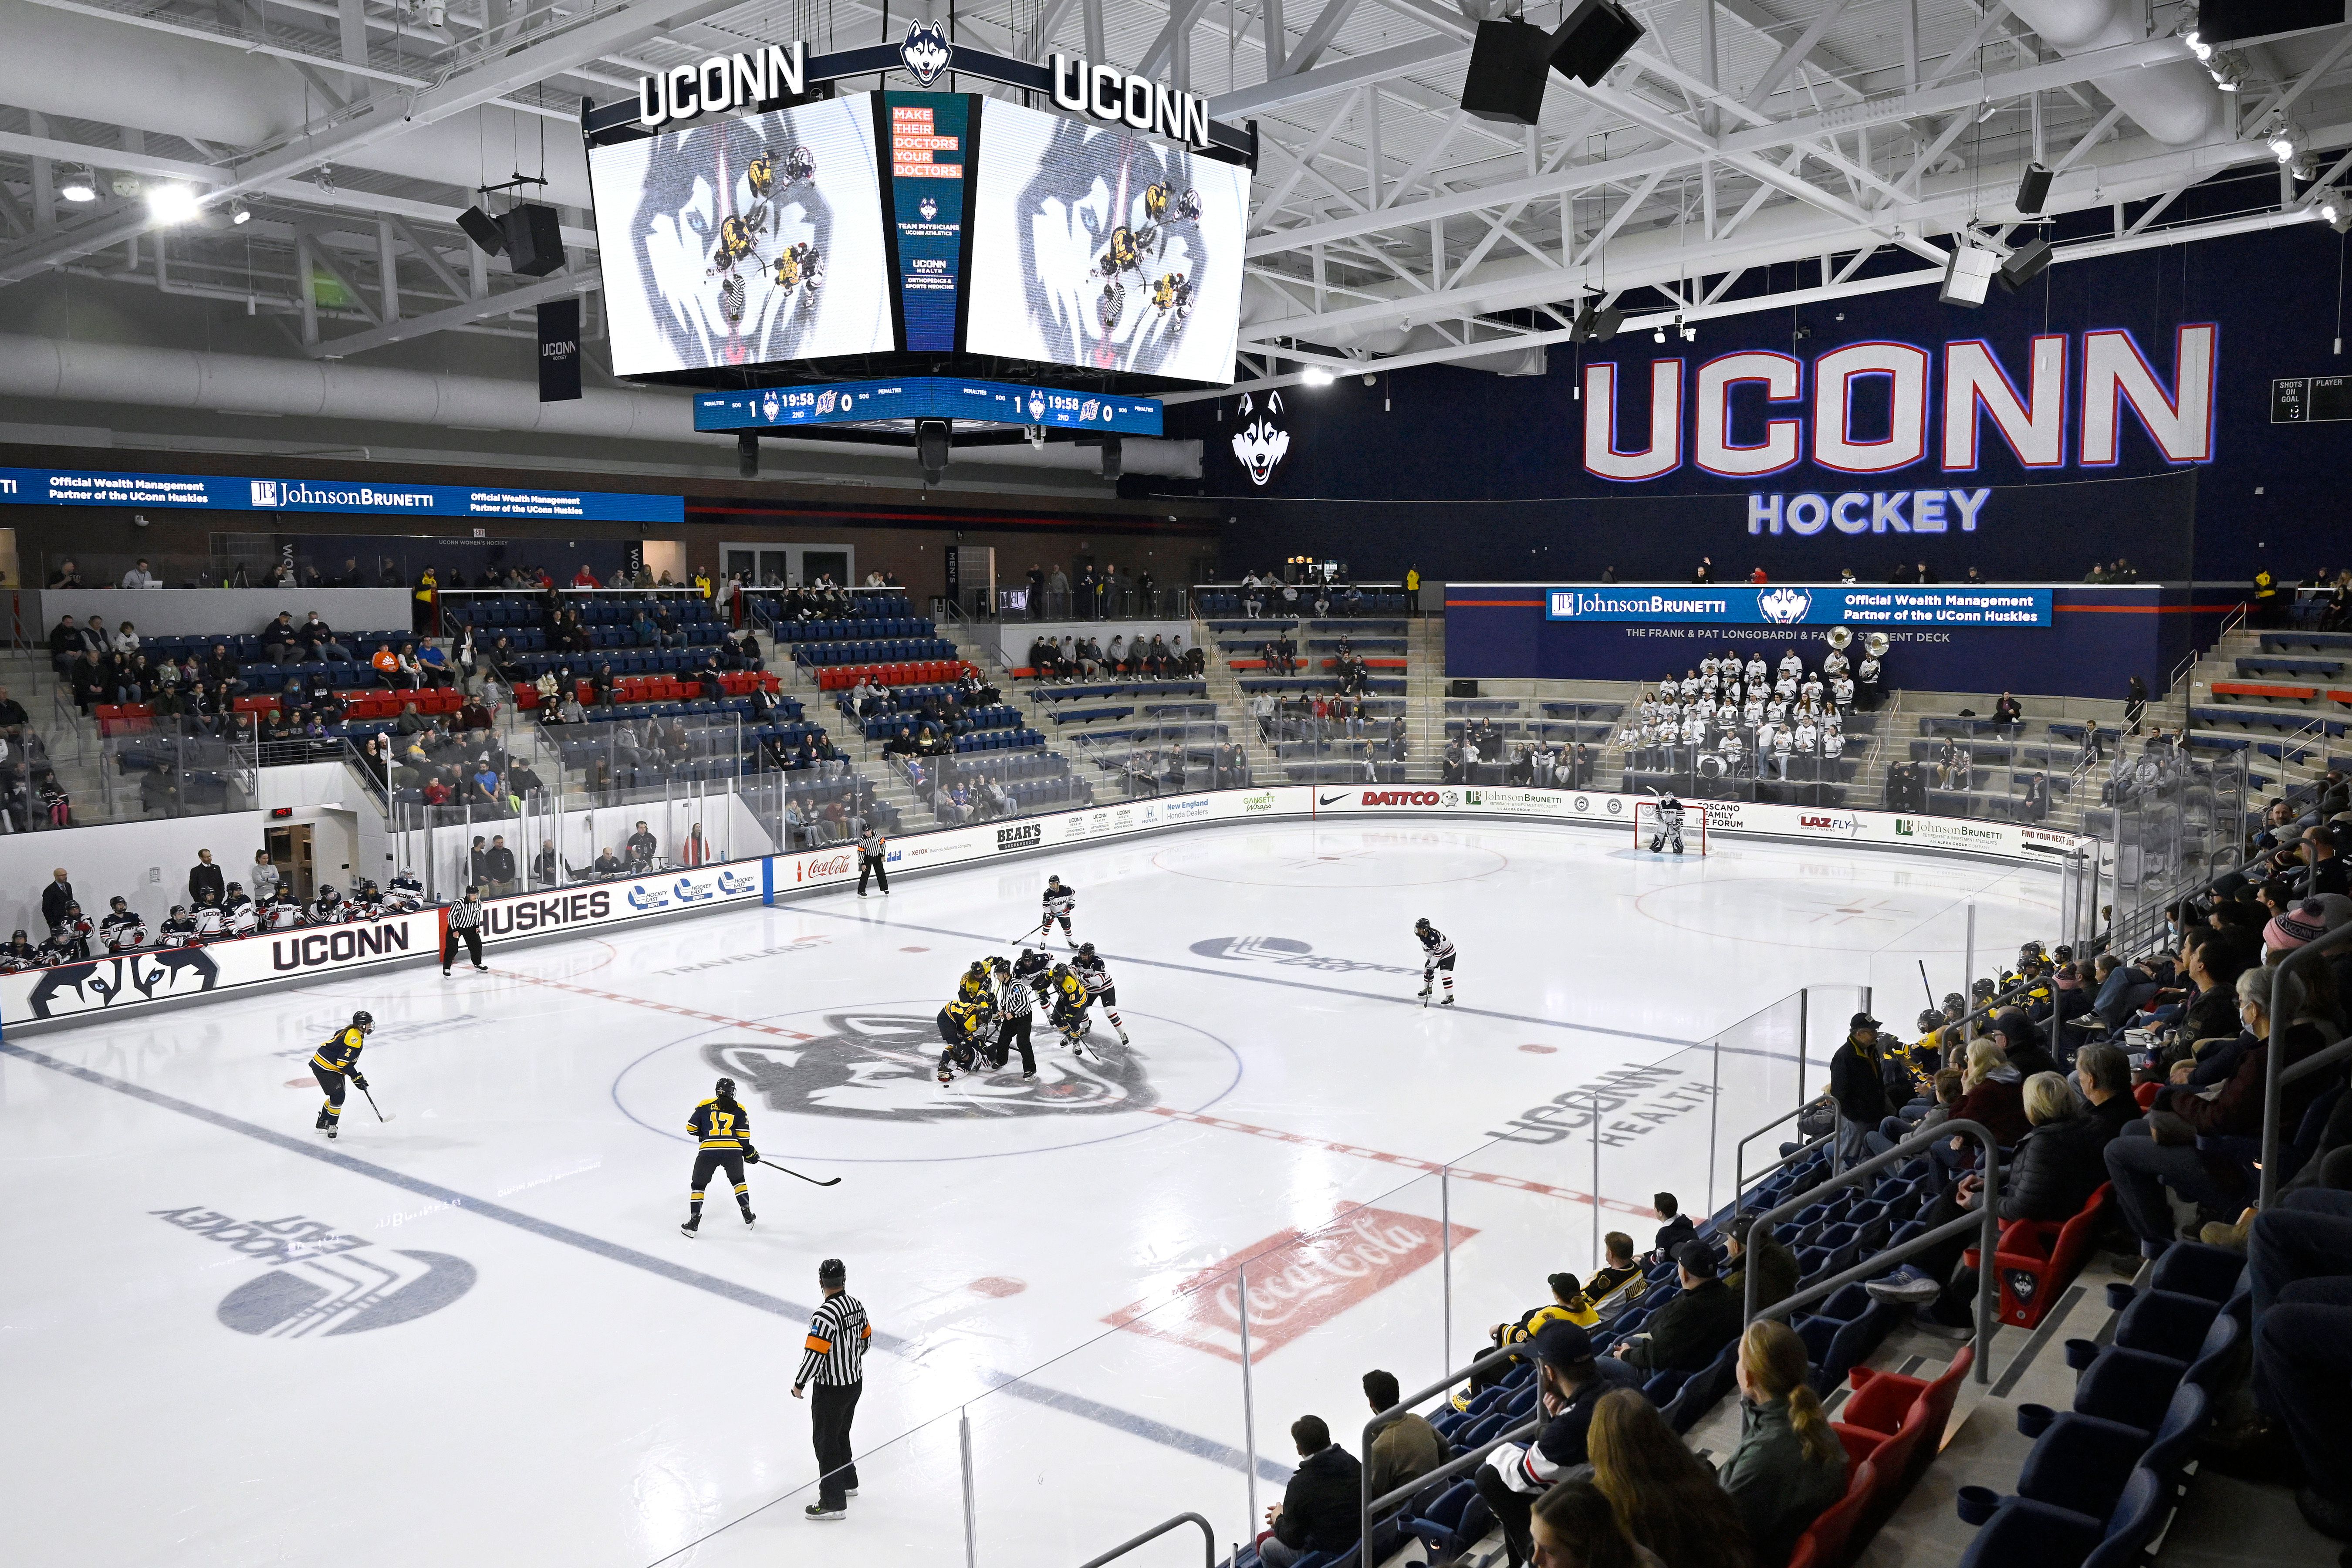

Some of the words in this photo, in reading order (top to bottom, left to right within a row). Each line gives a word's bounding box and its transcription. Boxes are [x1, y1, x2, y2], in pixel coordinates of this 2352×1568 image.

[639, 40, 804, 125] UCONN
[1054, 53, 1208, 147] UCONN
[894, 109, 930, 120] MAKE
[894, 123, 932, 135] THEIR
[895, 137, 957, 149] DOCTORS
[895, 151, 930, 162] YOUR
[896, 165, 960, 176] DOCTORS.
[912, 260, 946, 268] UCONN
[542, 340, 576, 356] UCONN
[749, 400, 757, 417] 1
[782, 392, 814, 407] 19:58
[841, 394, 852, 412] 0
[1014, 396, 1021, 413] 1
[1048, 395, 1079, 411] 19:58
[1103, 405, 1113, 422] 0
[1582, 323, 2216, 481] UCONN
[792, 411, 804, 419] 2ND
[1057, 413, 1069, 422] 2ND
[49, 477, 91, 487] Official
[94, 478, 133, 489] Wealth
[135, 480, 204, 491] Management
[49, 489, 92, 500] Partner
[94, 490, 107, 500] of
[109, 491, 128, 500] the
[130, 492, 166, 502] UConn
[168, 493, 209, 503] Huskies
[471, 493, 500, 502] Official
[501, 494, 530, 503] Wealth
[531, 495, 580, 505] Management
[470, 504, 500, 512] Partner
[527, 506, 553, 514] UConn
[554, 507, 583, 515] Huskies
[1747, 488, 1992, 533] HOCKEY
[1845, 595, 1891, 606] Official
[1894, 595, 1940, 606] Wealth
[1945, 595, 2034, 608] Management
[1844, 610, 1891, 621] Partner
[1894, 610, 1909, 621] of
[1911, 610, 1933, 621] the
[1936, 610, 1981, 622] UConn
[1984, 611, 2038, 622] Huskies
[1626, 629, 1646, 637] THE
[1649, 629, 1685, 638] FRANK
[1688, 629, 1695, 638] &
[1698, 630, 1719, 639] PAT
[1722, 630, 1797, 640] LONGOBARDI
[1800, 631, 1808, 640] &
[1916, 633, 1950, 642] DECK
[1182, 799, 1208, 809] England
[1243, 796, 1275, 804] GANSETT
[1361, 791, 1440, 806] DATTCO
[1186, 809, 1208, 818] Dealers
[1246, 801, 1271, 812] Wraps
[1712, 819, 1743, 828] FORUM
[1801, 816, 1831, 828] LAZ
[1832, 820, 1851, 829] FLY
[997, 824, 1041, 843] BEAR'S
[2021, 830, 2034, 838] FIND
[2036, 832, 2051, 841] YOUR
[2052, 835, 2065, 845] NEXT
[1005, 840, 1034, 848] SMOKEHOUSE
[886, 850, 901, 862] CBS
[808, 855, 852, 879] Coca-Cola
[479, 891, 610, 936] HUSKIES
[2285, 922, 2312, 939] UCONN
[273, 922, 409, 971] UCONN
[652, 942, 818, 976] TRAVELERS
[1273, 957, 1360, 973] EAST
[1297, 954, 1429, 976] HOCKEY
[344, 1048, 352, 1057] 2
[1485, 1062, 1684, 1145] UCONN
[1587, 1082, 1723, 1148] HEALTH
[709, 1111, 735, 1136] 17
[147, 1205, 321, 1266] HOCKEY
[243, 1214, 375, 1256] EAST
